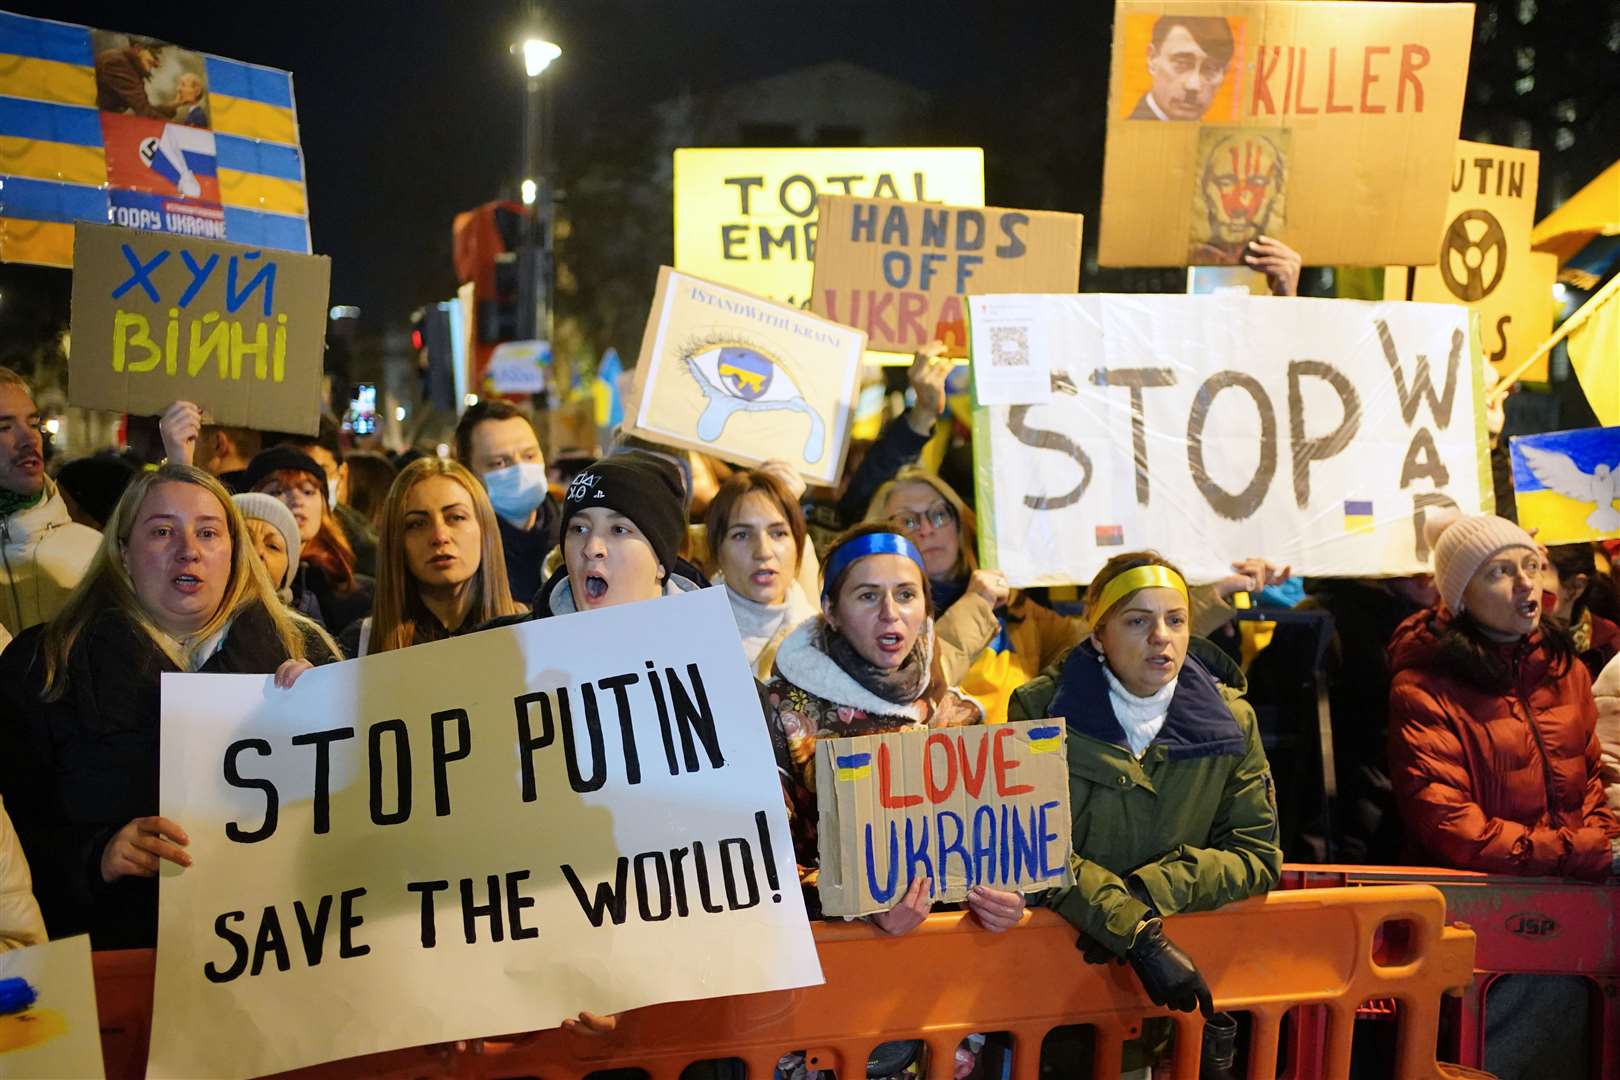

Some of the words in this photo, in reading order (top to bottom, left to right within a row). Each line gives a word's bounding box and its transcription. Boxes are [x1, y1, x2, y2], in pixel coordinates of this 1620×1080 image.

[1251, 44, 1431, 116] KILLER
[108, 206, 162, 229] TODAY
[851, 204, 1029, 258] HANDS
[112, 244, 277, 317] ХУЙ
[882, 251, 984, 294] OFF
[112, 308, 288, 382] ВІЙНІ
[1006, 359, 1362, 521] STOP
[223, 707, 473, 844] STOP
[877, 727, 1035, 809] LOVE
[865, 800, 1065, 904] UKRAINE
[204, 886, 371, 984] SAVE
[407, 869, 539, 948] THE
[1513, 919, 1556, 935] JSP
